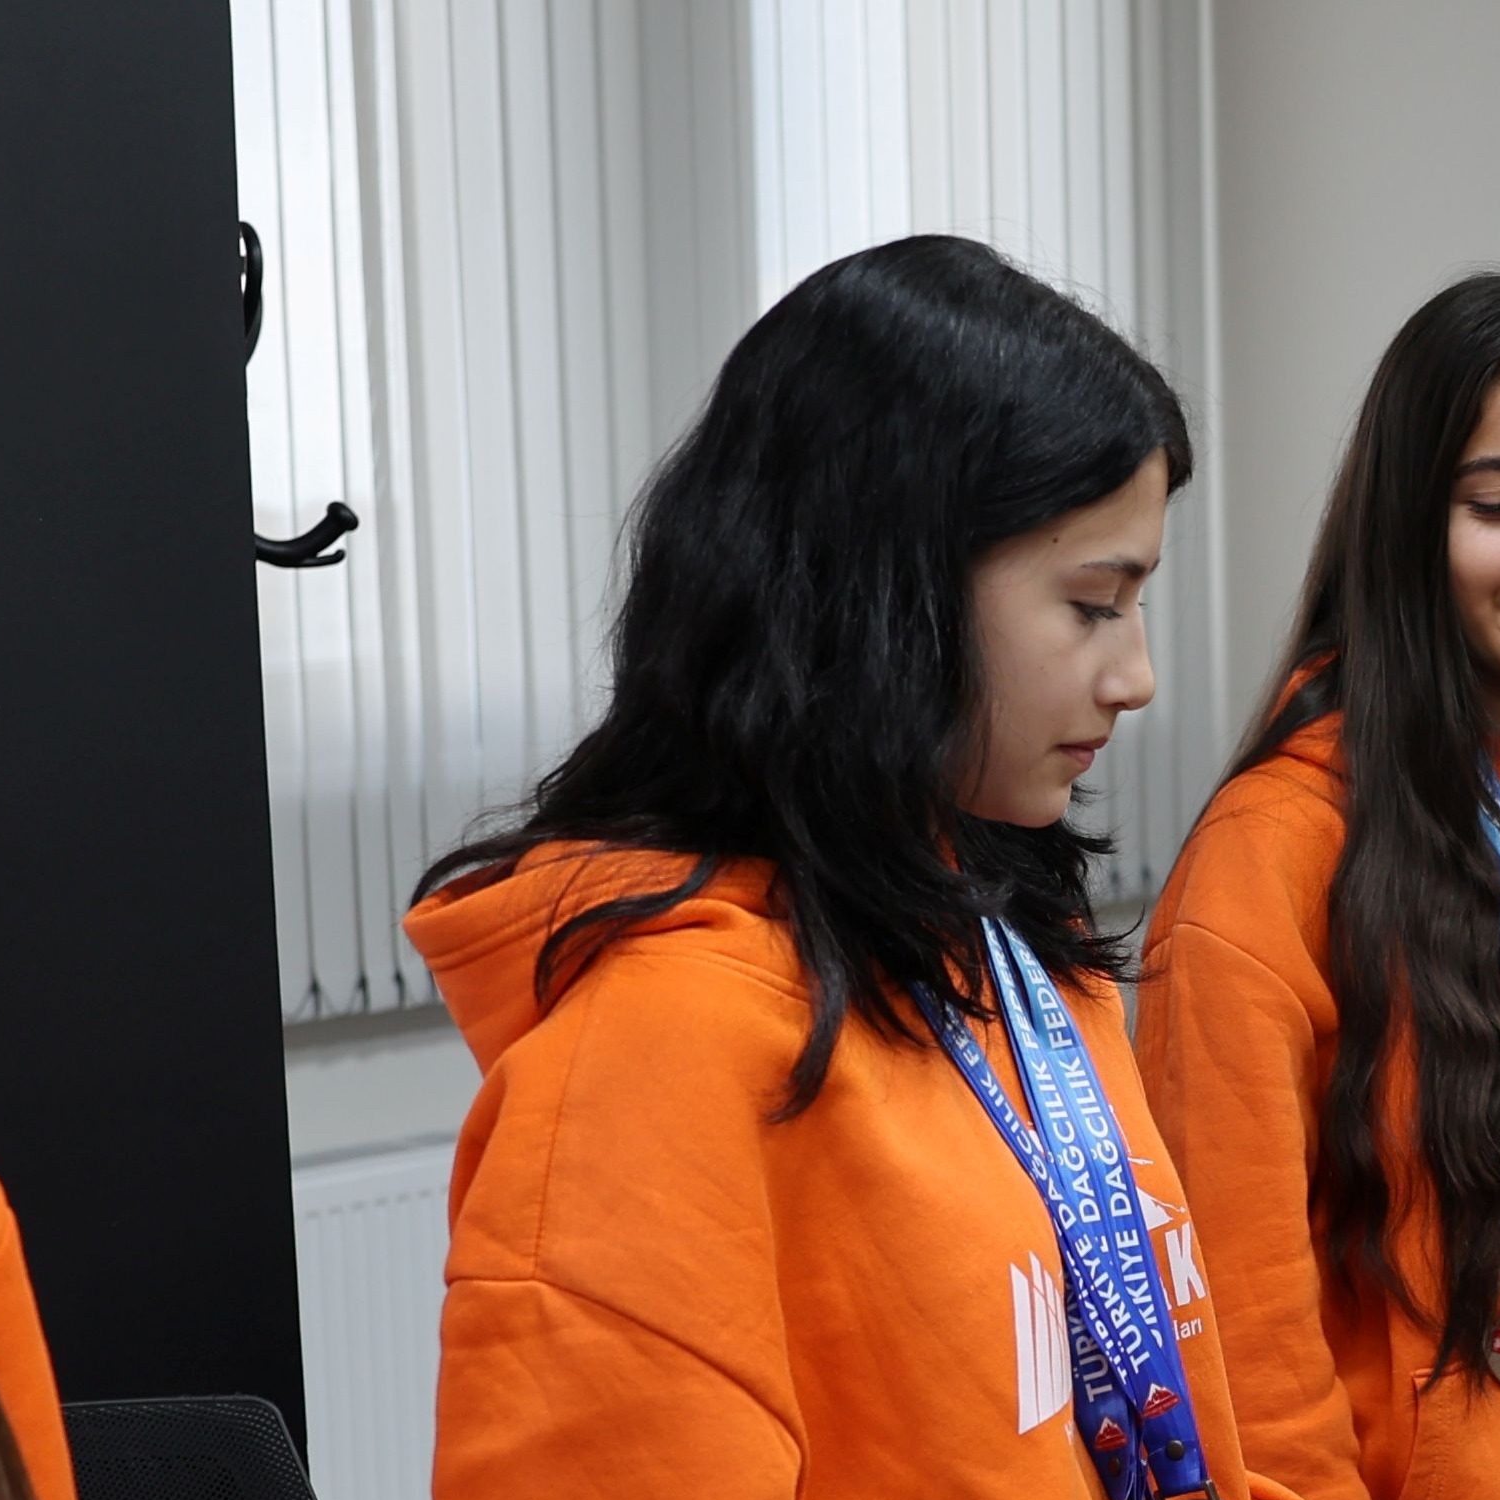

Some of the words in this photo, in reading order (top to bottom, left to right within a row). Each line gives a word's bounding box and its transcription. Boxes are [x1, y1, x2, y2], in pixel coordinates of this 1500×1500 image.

[981, 1073, 1078, 1231] DAĞCILIK
[1032, 1061, 1101, 1224] DAĞCILIK
[1059, 1055, 1134, 1218] DAĞCILIK
[1075, 1233, 1150, 1374] TÜRKİYE
